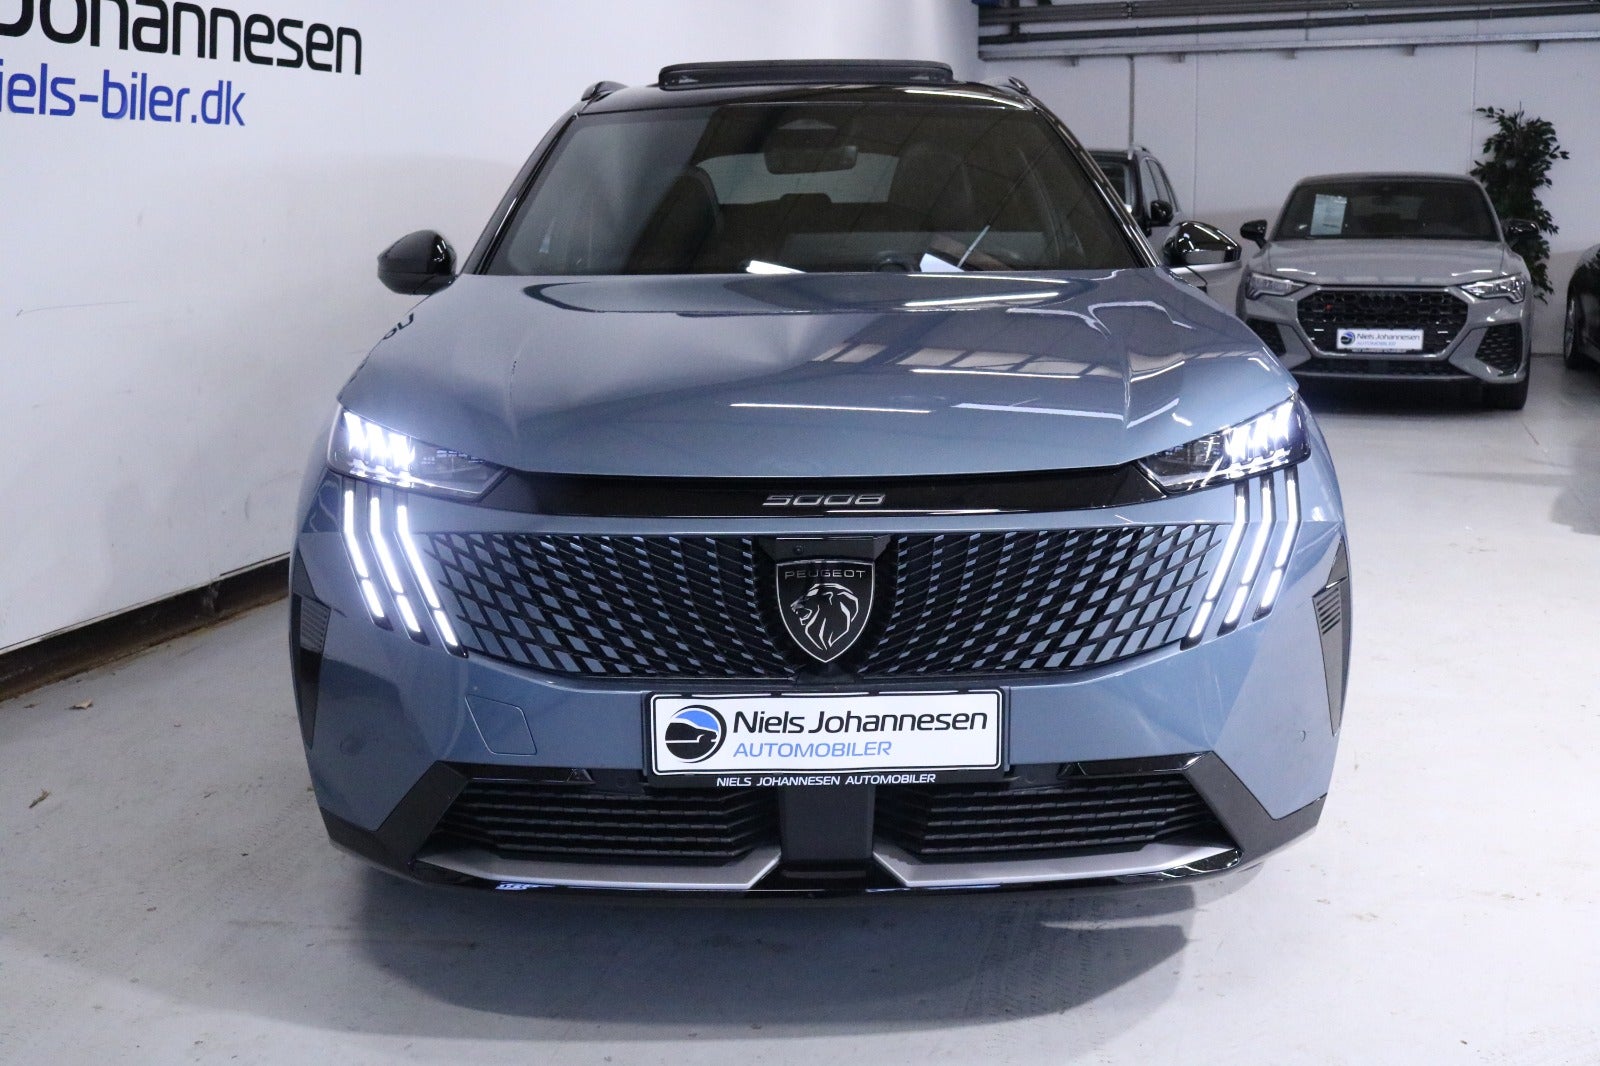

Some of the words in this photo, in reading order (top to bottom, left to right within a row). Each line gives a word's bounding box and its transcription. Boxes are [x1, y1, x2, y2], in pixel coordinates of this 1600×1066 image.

[762, 493, 886, 506] 5008
[784, 569, 866, 580] PEUGEOT
[733, 710, 805, 734] Niels
[808, 710, 988, 734] Johannesen
[733, 741, 893, 758] AUTOMOBILER
[716, 777, 752, 787] NIELS
[756, 776, 841, 786] JOHANNESEN
[845, 773, 936, 785] AUTOMOBILER
